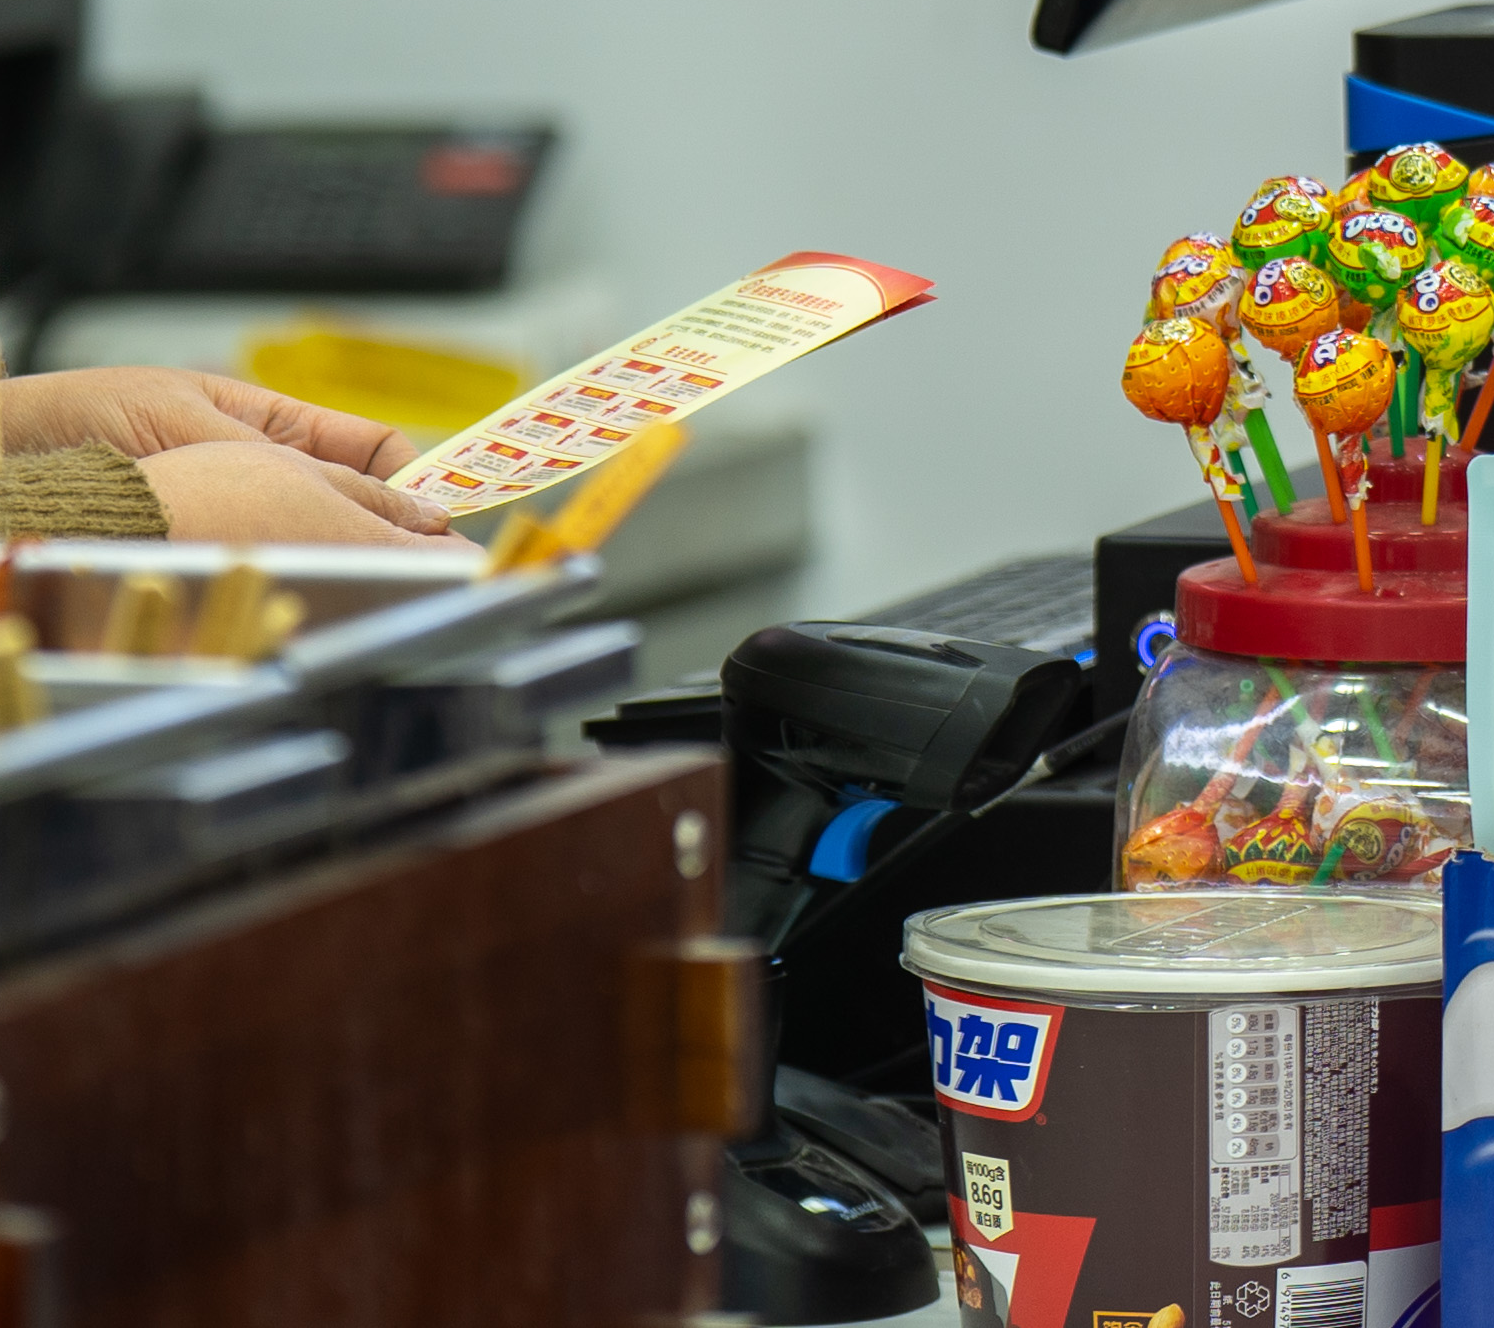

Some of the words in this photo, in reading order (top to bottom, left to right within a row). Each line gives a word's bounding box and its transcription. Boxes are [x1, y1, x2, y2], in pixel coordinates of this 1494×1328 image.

[964, 1159, 1006, 1183] 每100g含
[971, 1182, 1004, 1210] 8.6g
[974, 1211, 1004, 1231] 蛋白质
